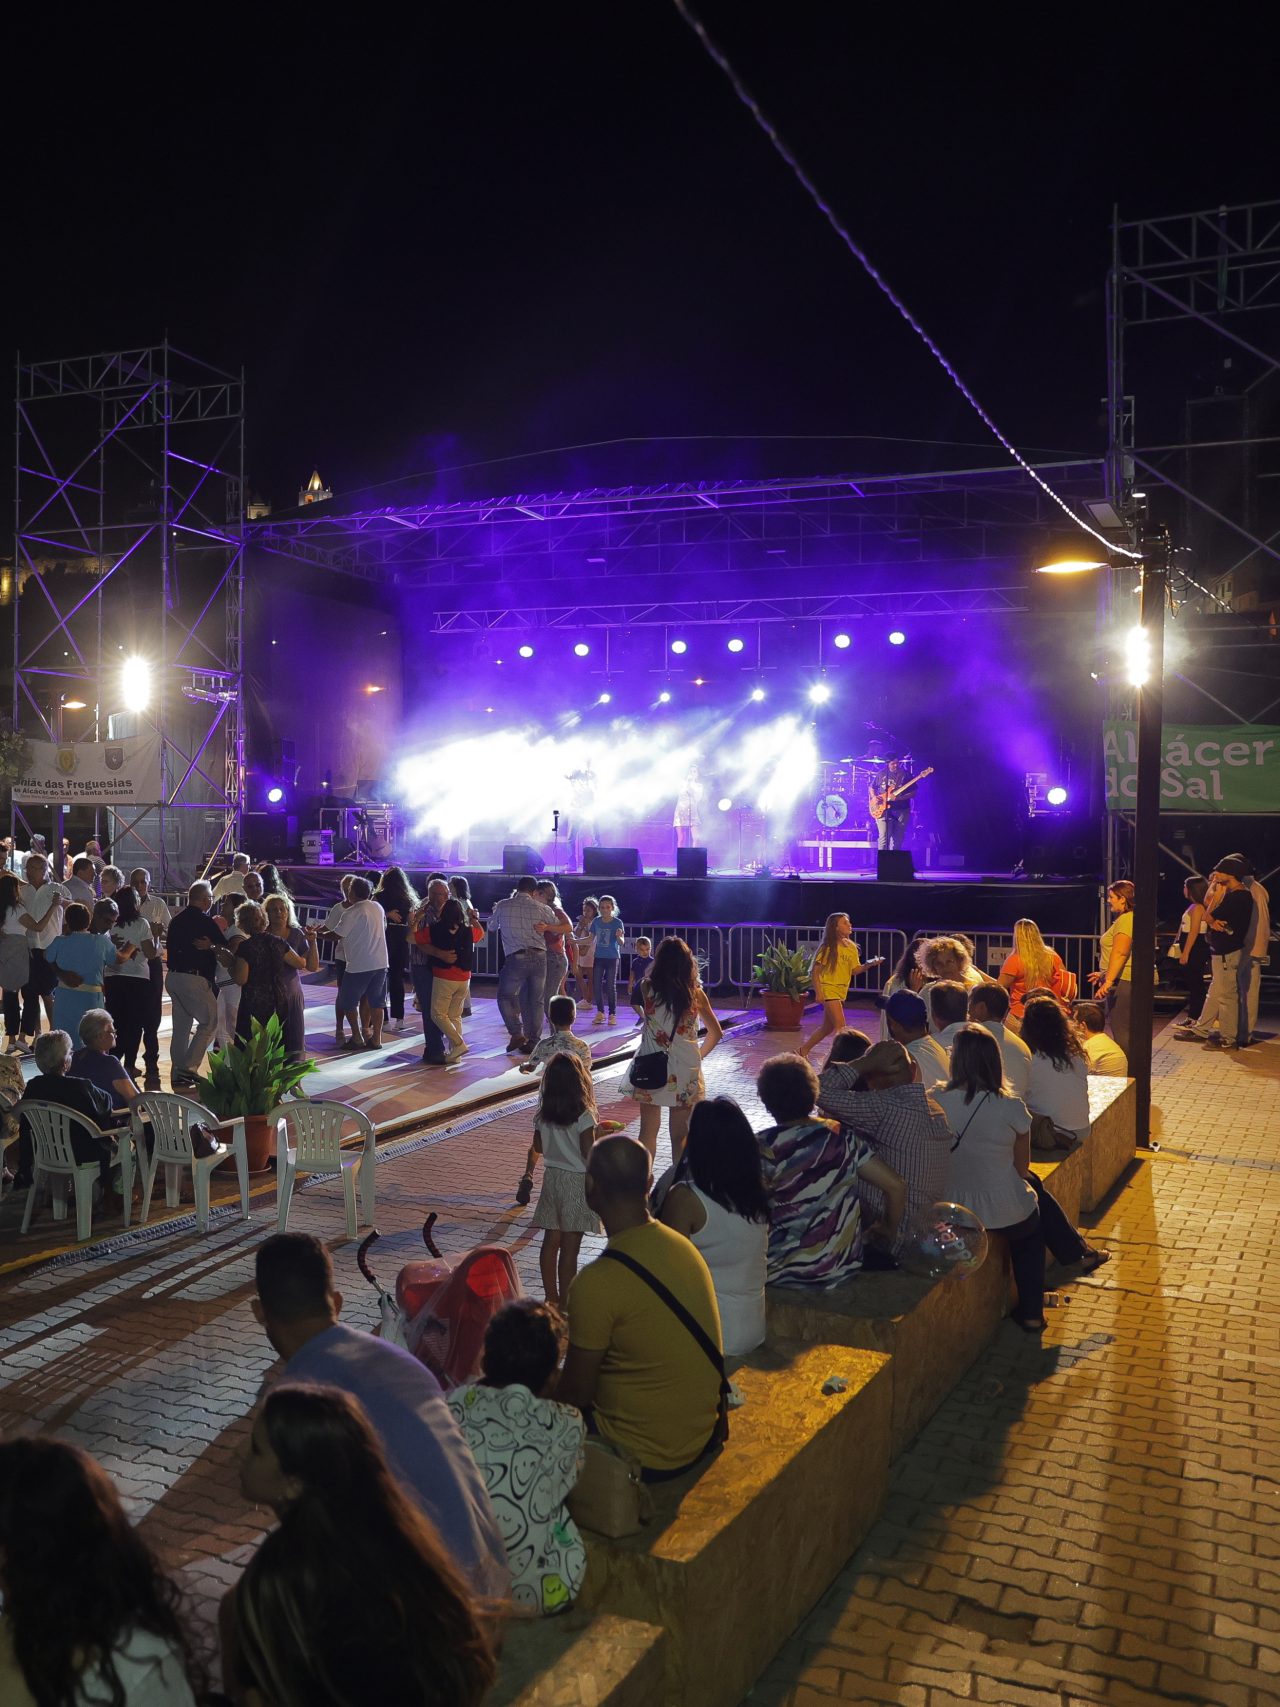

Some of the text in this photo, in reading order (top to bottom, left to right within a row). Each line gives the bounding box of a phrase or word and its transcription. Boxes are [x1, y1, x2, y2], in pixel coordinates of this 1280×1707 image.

[1104, 730, 1274, 767] Alácer
[45, 780, 64, 789] das
[67, 778, 132, 790] Freguesias
[1160, 768, 1224, 800] Sal
